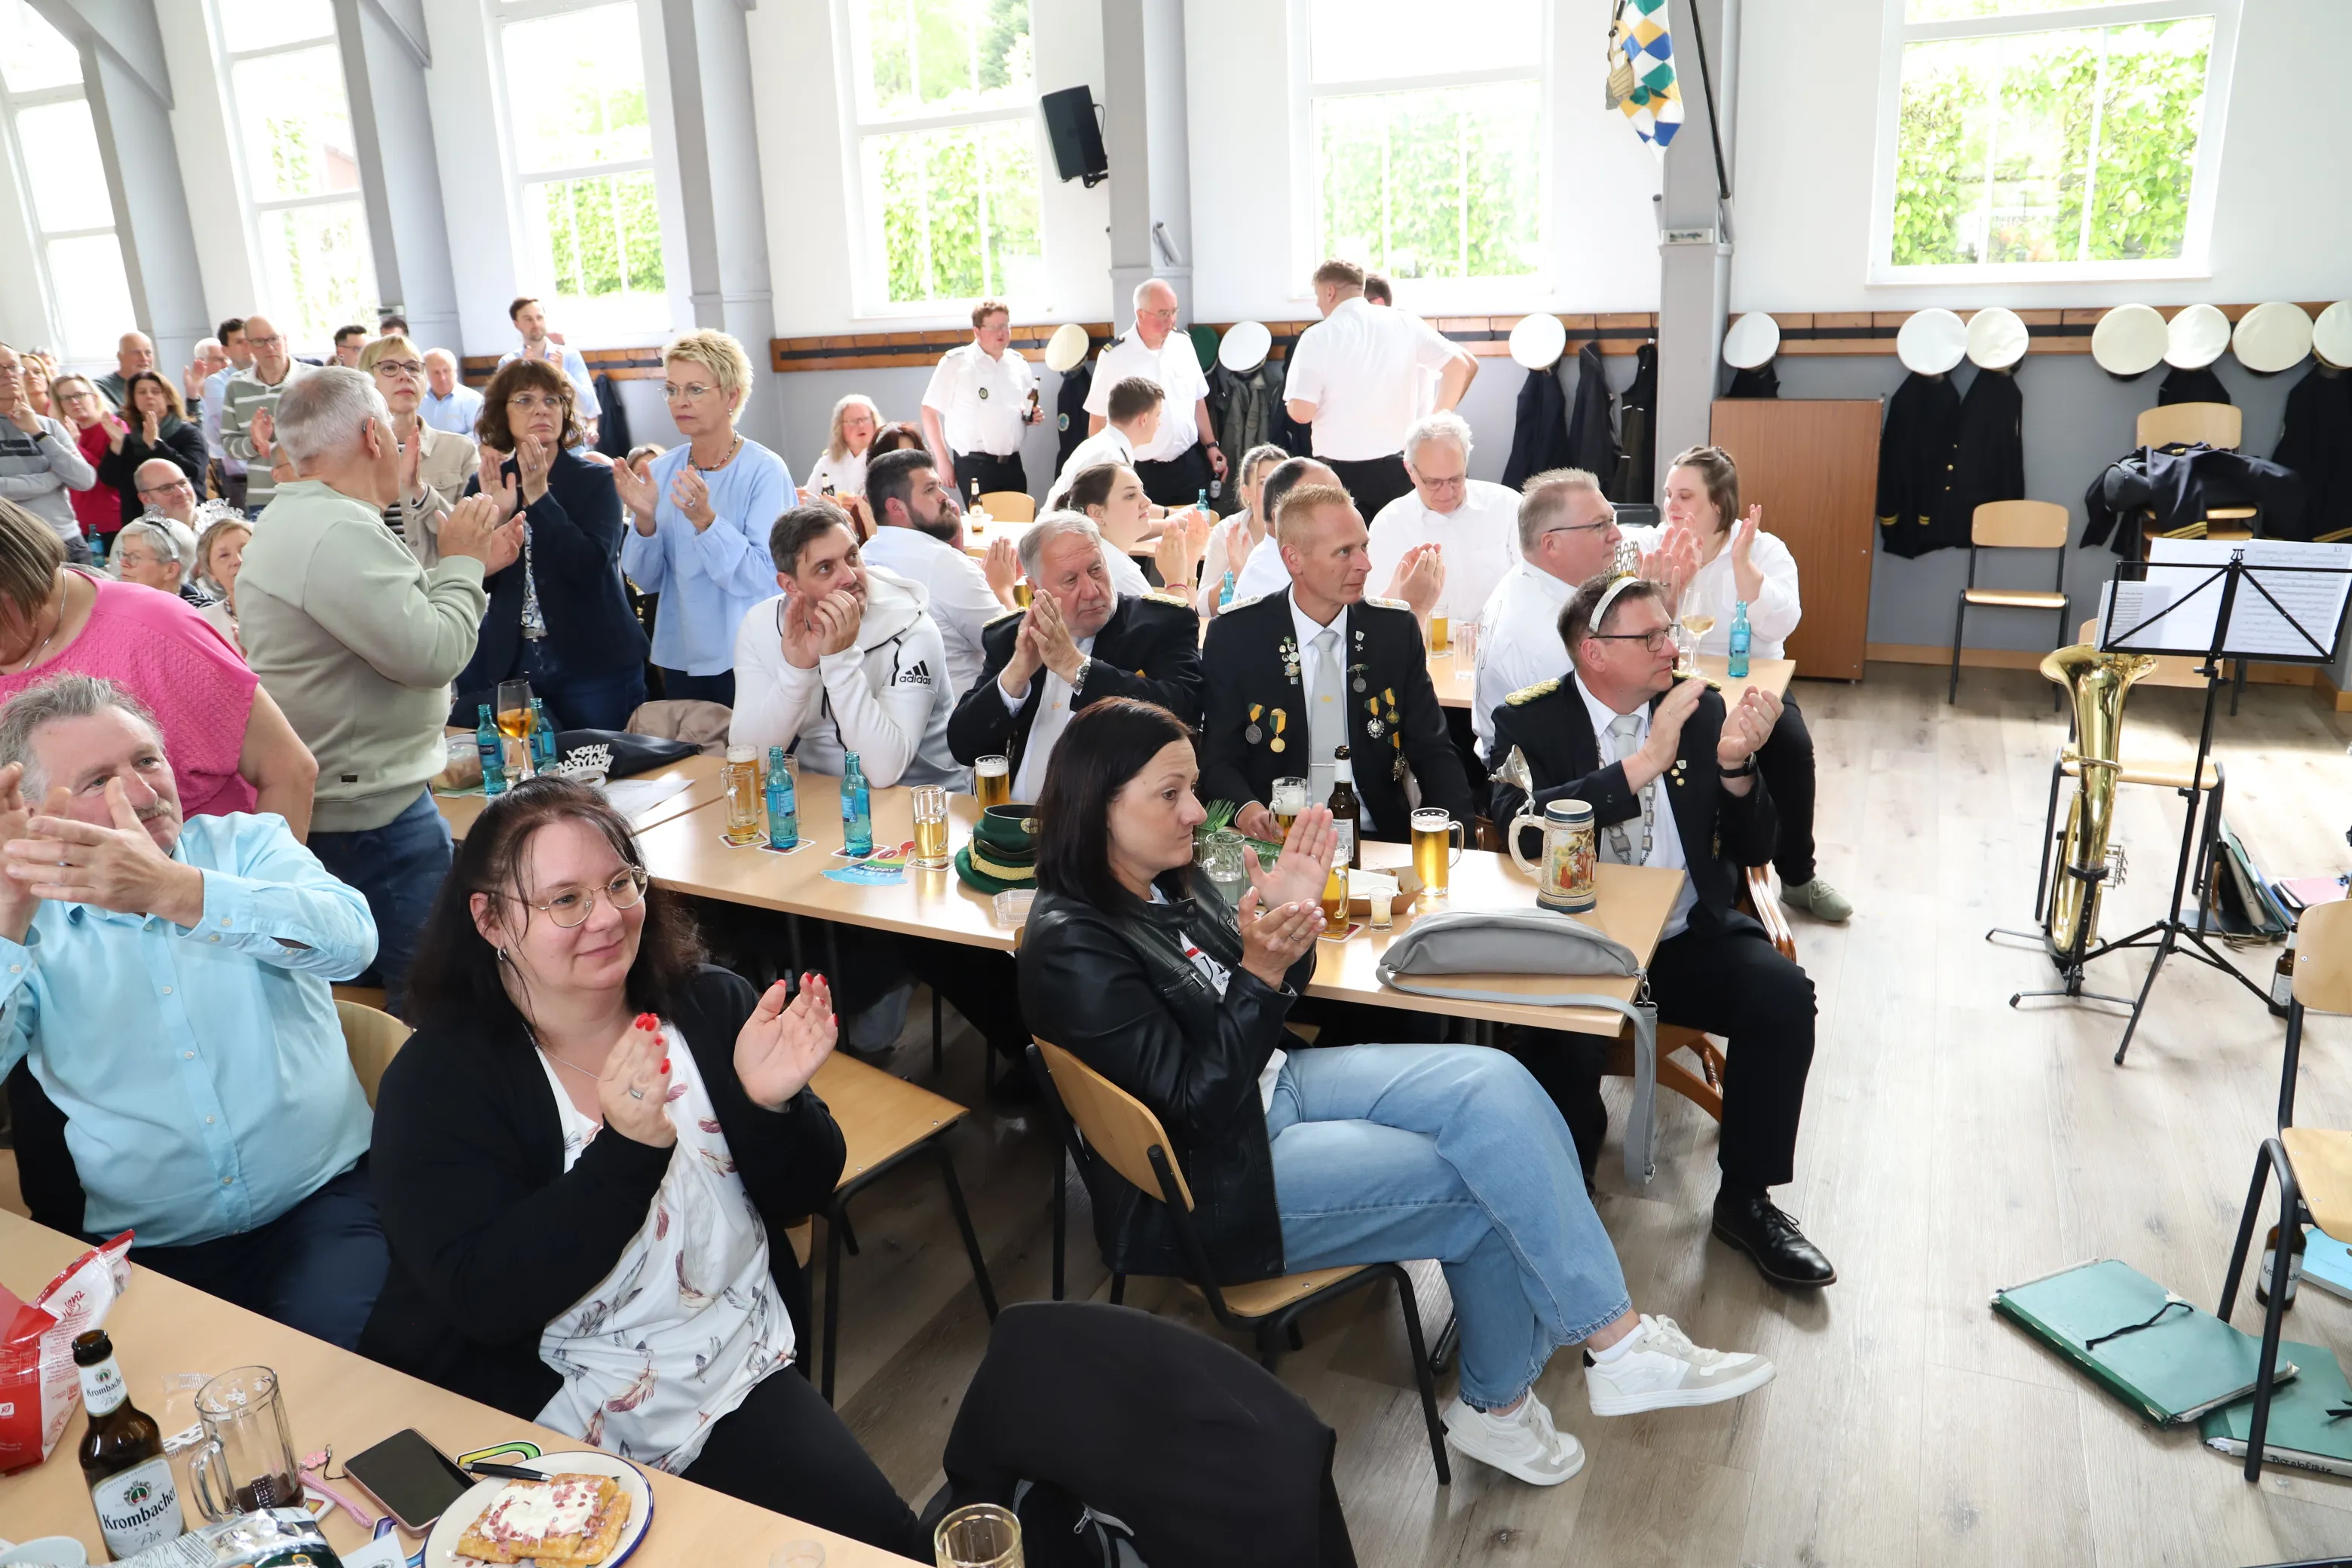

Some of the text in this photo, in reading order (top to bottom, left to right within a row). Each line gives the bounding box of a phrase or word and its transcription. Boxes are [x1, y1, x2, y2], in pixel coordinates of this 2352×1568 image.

[899, 675, 931, 684] adidas
[846, 868, 896, 877] PARTY
[102, 1484, 176, 1530] Krombacher
[135, 1529, 162, 1546] Pils
